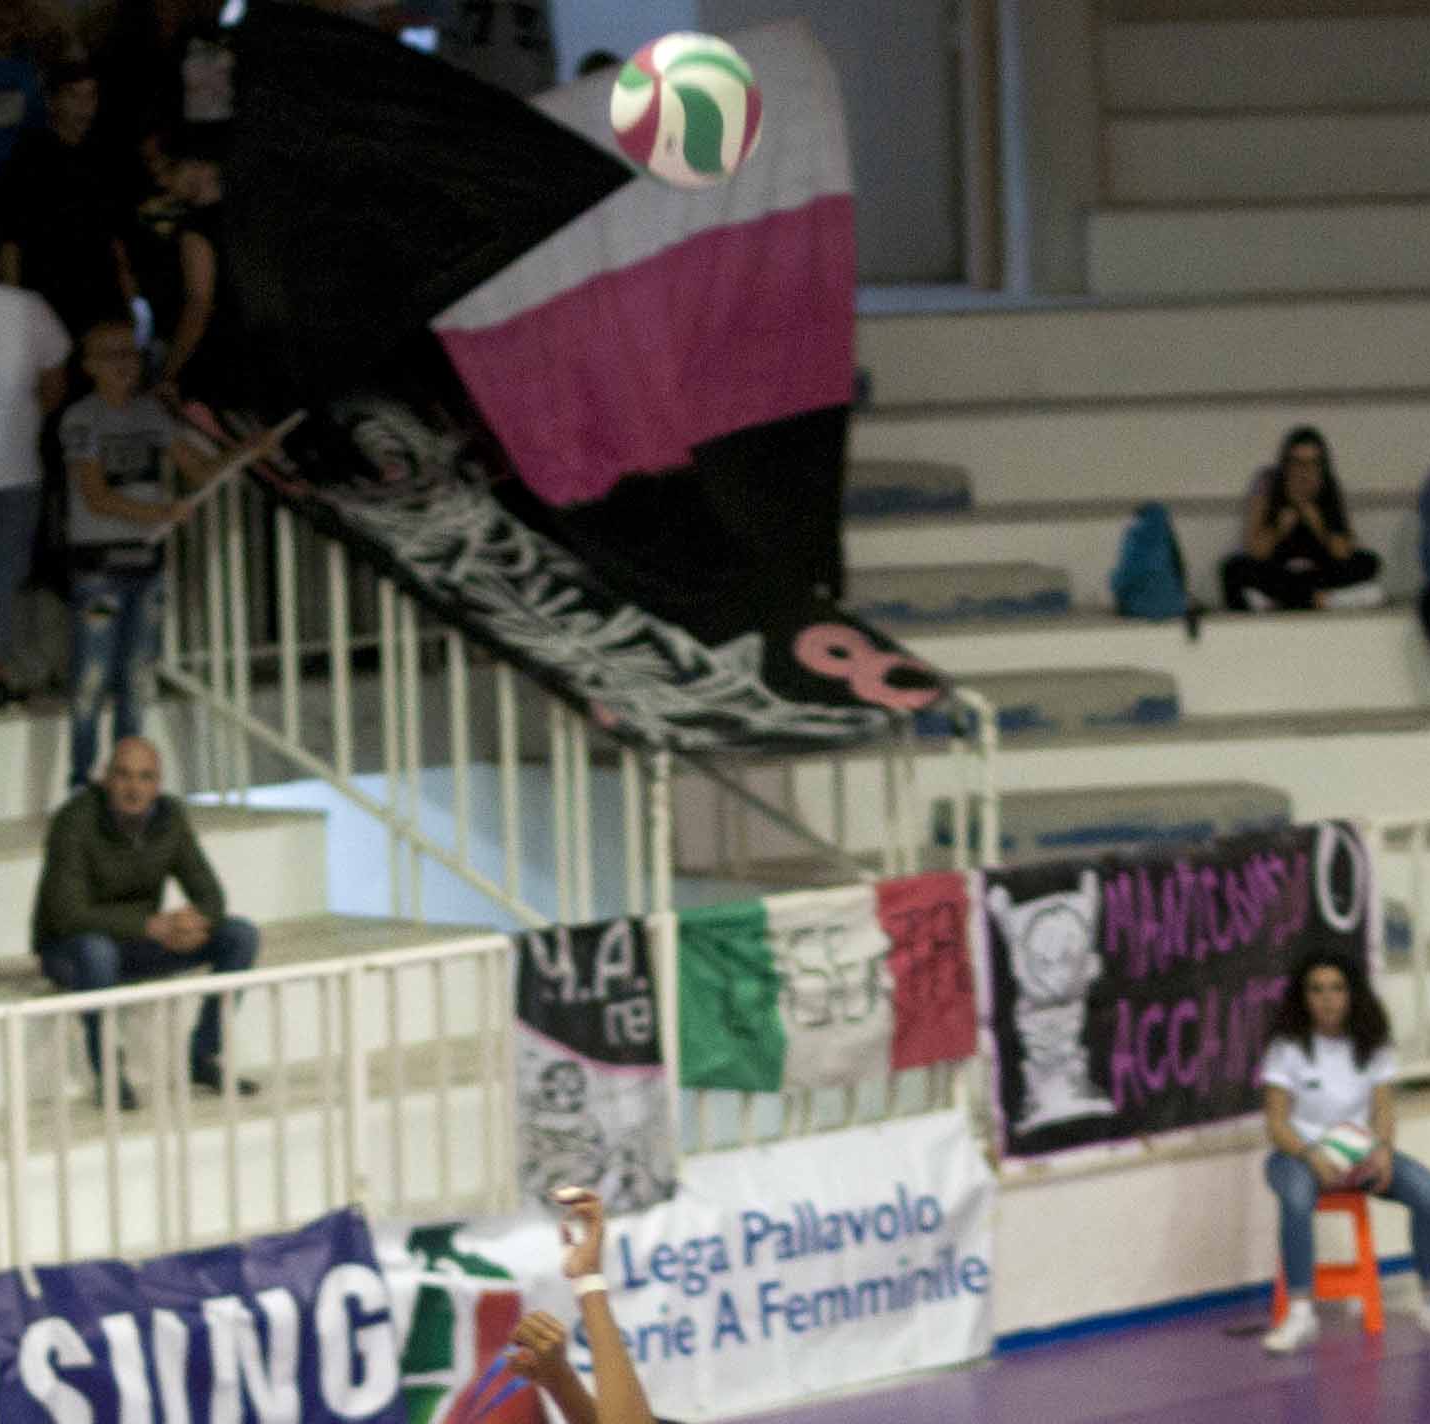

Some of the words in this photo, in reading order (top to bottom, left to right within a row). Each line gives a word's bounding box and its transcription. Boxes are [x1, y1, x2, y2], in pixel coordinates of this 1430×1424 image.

[618, 1232, 730, 1297] Lega
[741, 1184, 944, 1267] Pallavolo
[574, 1303, 696, 1374] Srie
[711, 1291, 746, 1350] A
[759, 1244, 989, 1339] Femminile
